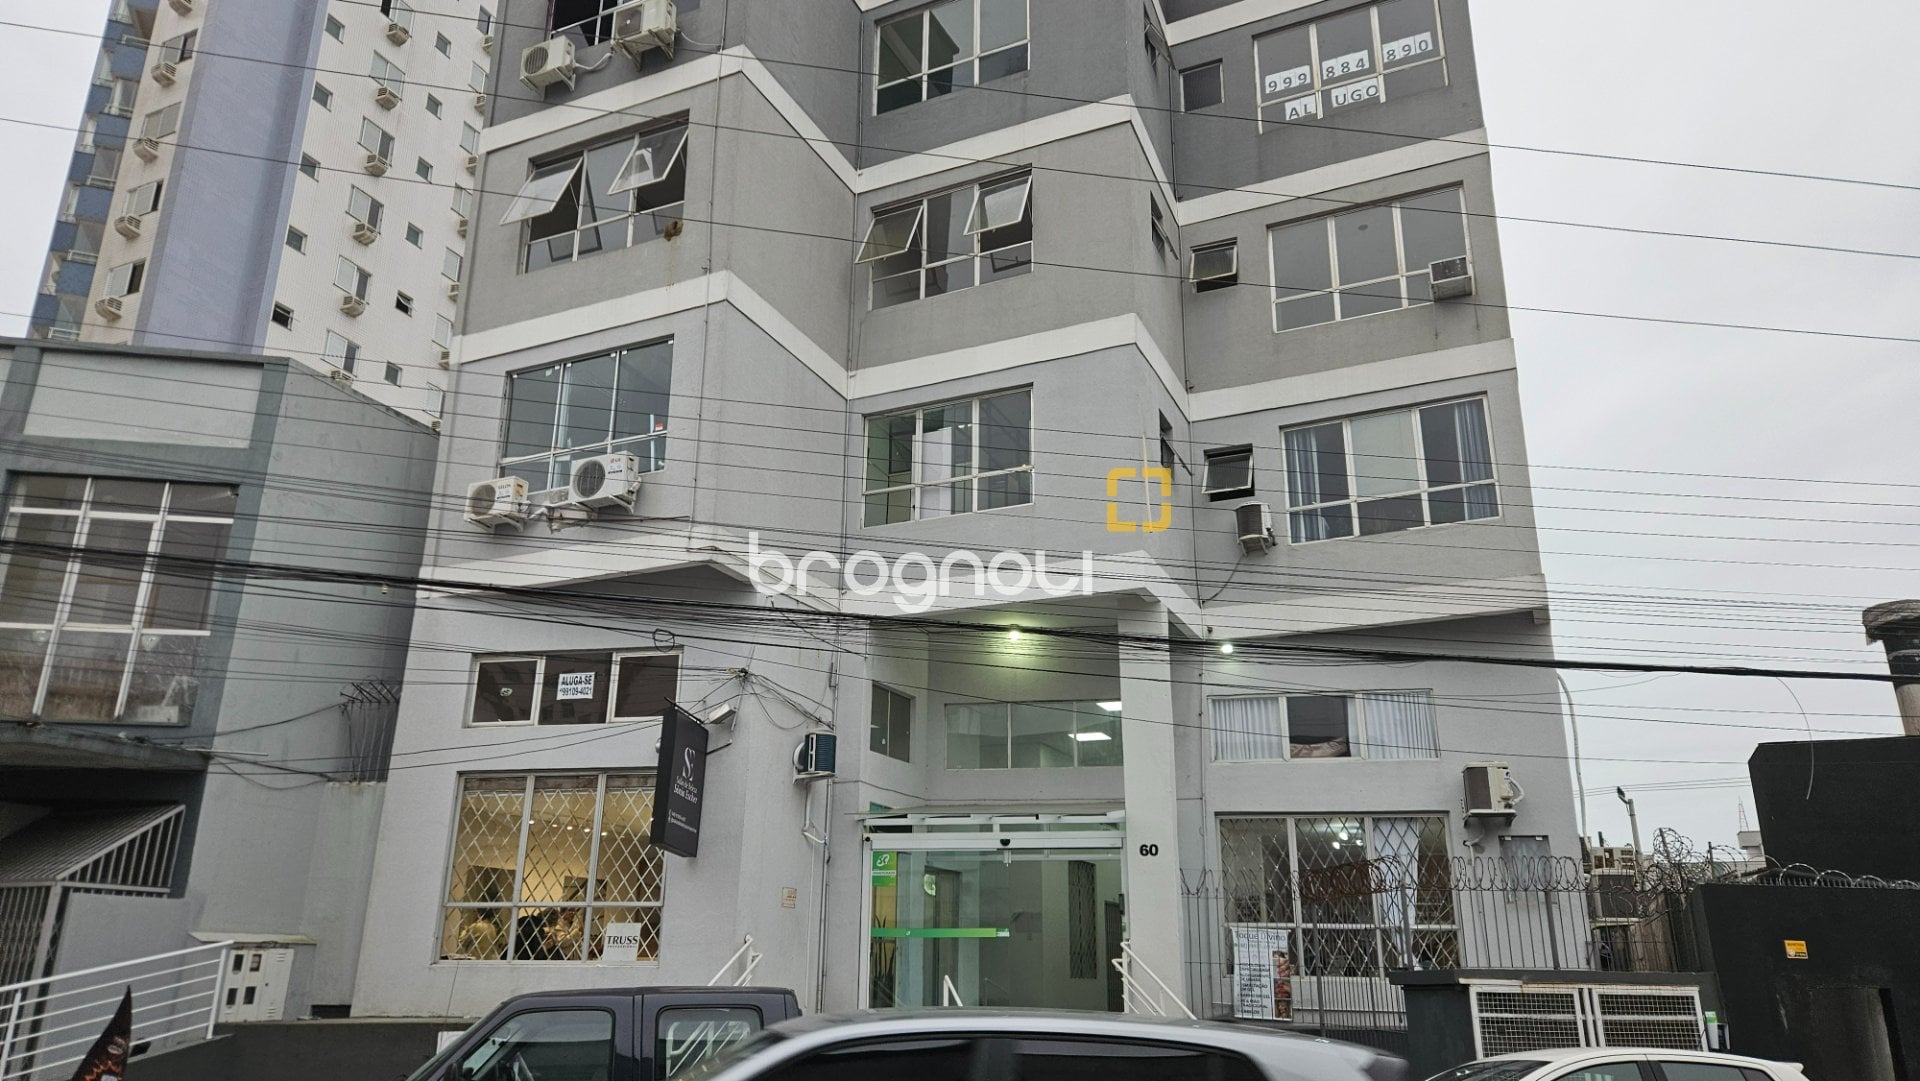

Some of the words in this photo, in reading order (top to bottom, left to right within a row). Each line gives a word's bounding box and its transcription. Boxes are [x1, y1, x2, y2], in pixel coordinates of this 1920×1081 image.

[1268, 72, 1308, 92] 999
[1325, 57, 1367, 79] 884
[1386, 39, 1429, 61] 890
[561, 675, 592, 686] ALUGA-SE
[1139, 844, 1159, 856] 60
[606, 935, 639, 945] TRUSS
